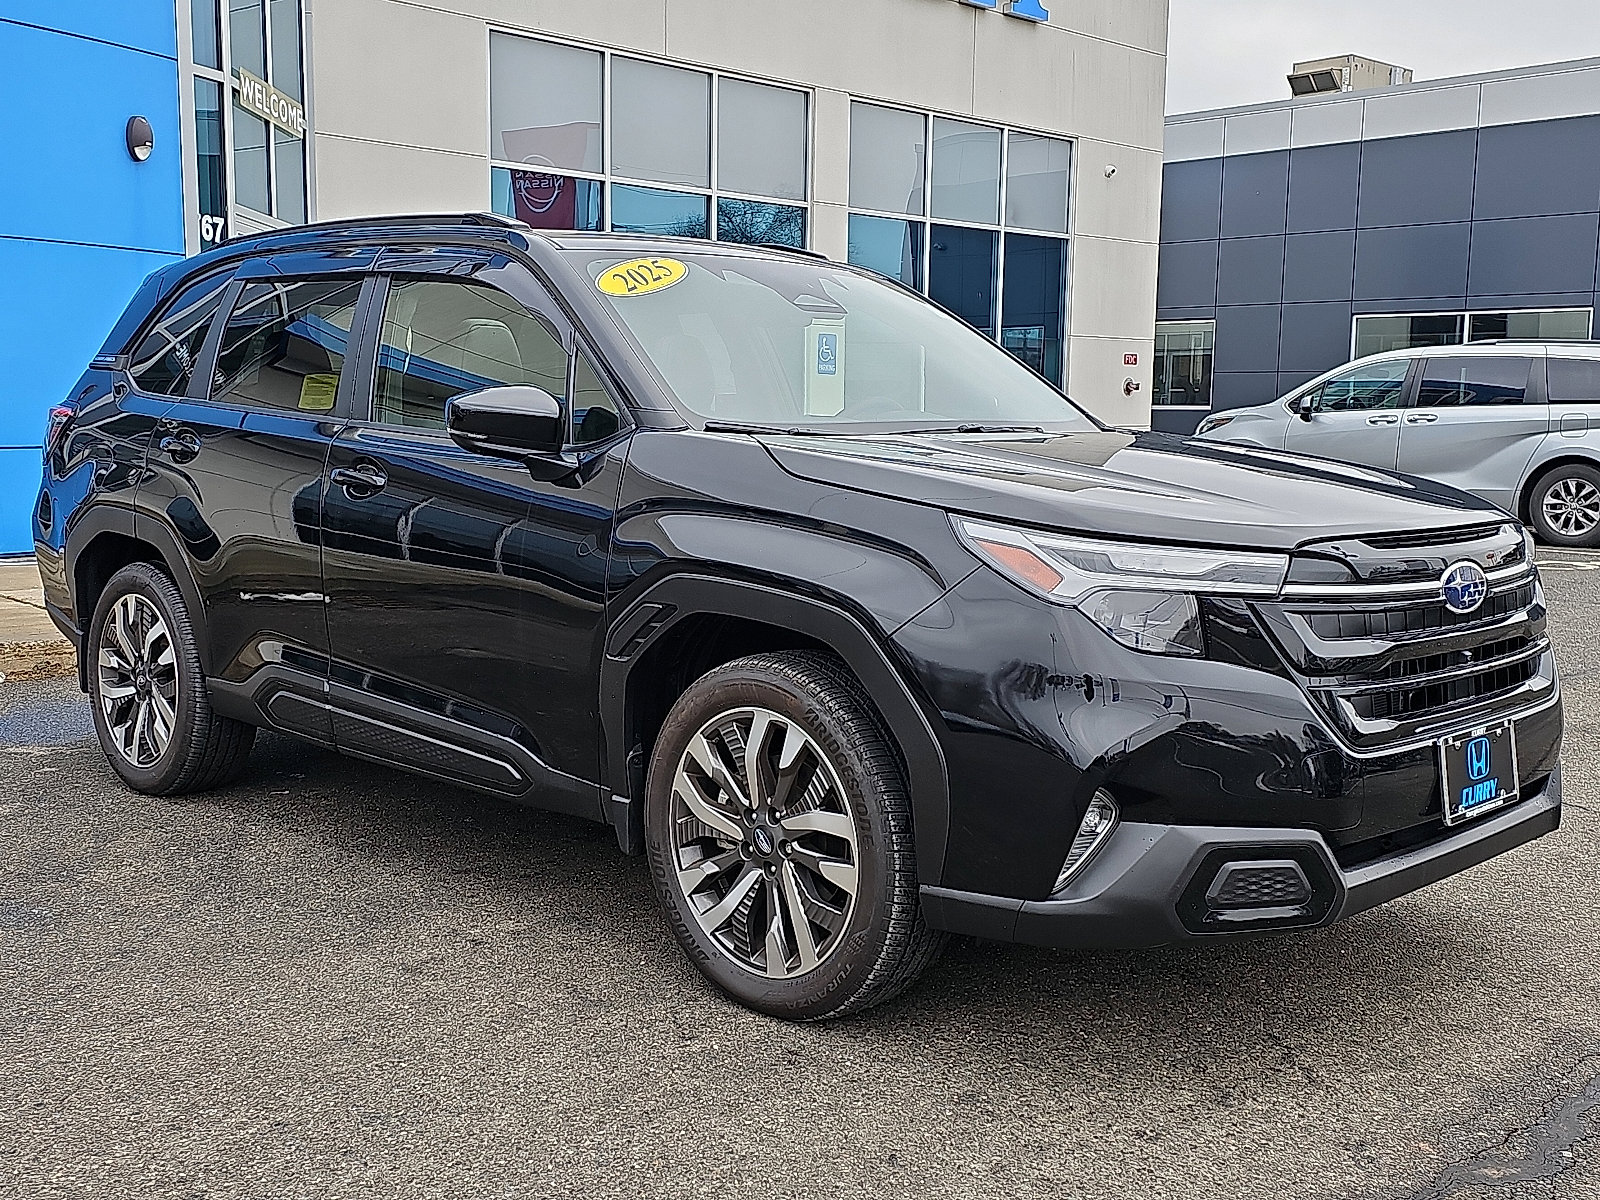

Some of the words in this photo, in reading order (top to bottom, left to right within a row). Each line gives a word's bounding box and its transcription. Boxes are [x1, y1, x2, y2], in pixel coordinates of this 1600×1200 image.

[240, 74, 303, 131] WELCOME
[198, 214, 224, 243] 67
[612, 260, 672, 292] 2025
[1125, 355, 1137, 364] FDC
[1462, 778, 1498, 807] CURRY
